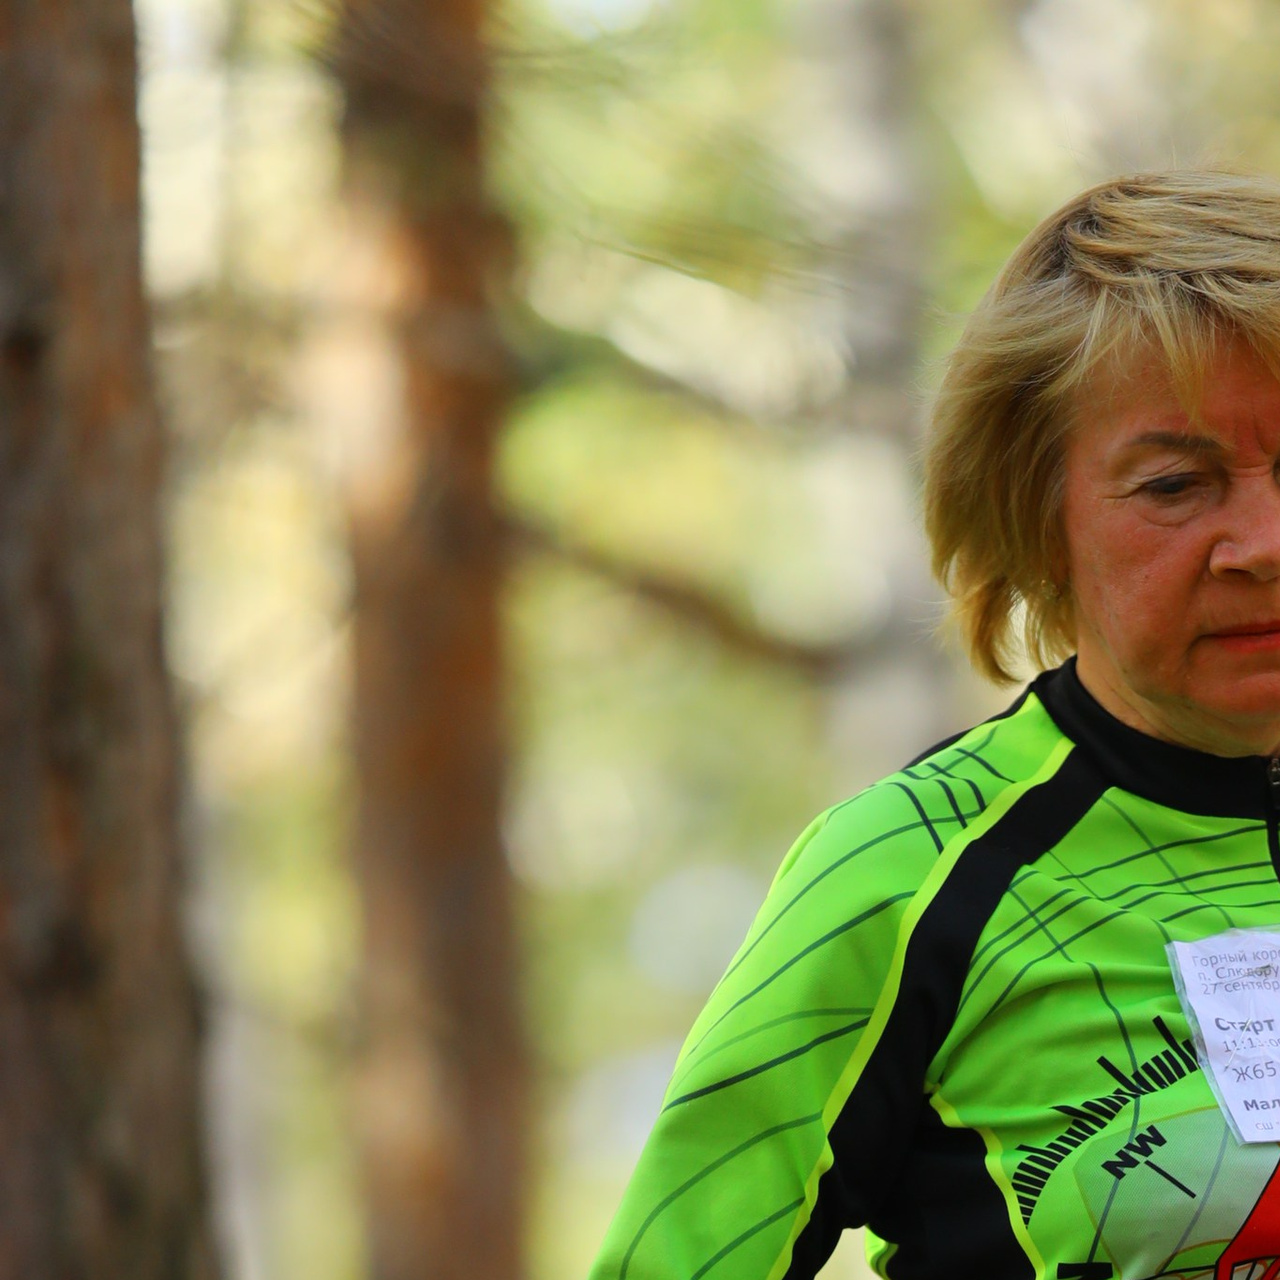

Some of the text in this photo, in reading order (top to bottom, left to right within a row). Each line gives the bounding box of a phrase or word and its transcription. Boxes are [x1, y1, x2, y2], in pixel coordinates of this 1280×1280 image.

[1192, 949, 1248, 968] Горный
[1201, 981, 1219, 995] 27
[1214, 1016, 1275, 1036] Старт
[1232, 1060, 1277, 1083] Ж65
[1101, 1124, 1168, 1181] NW
